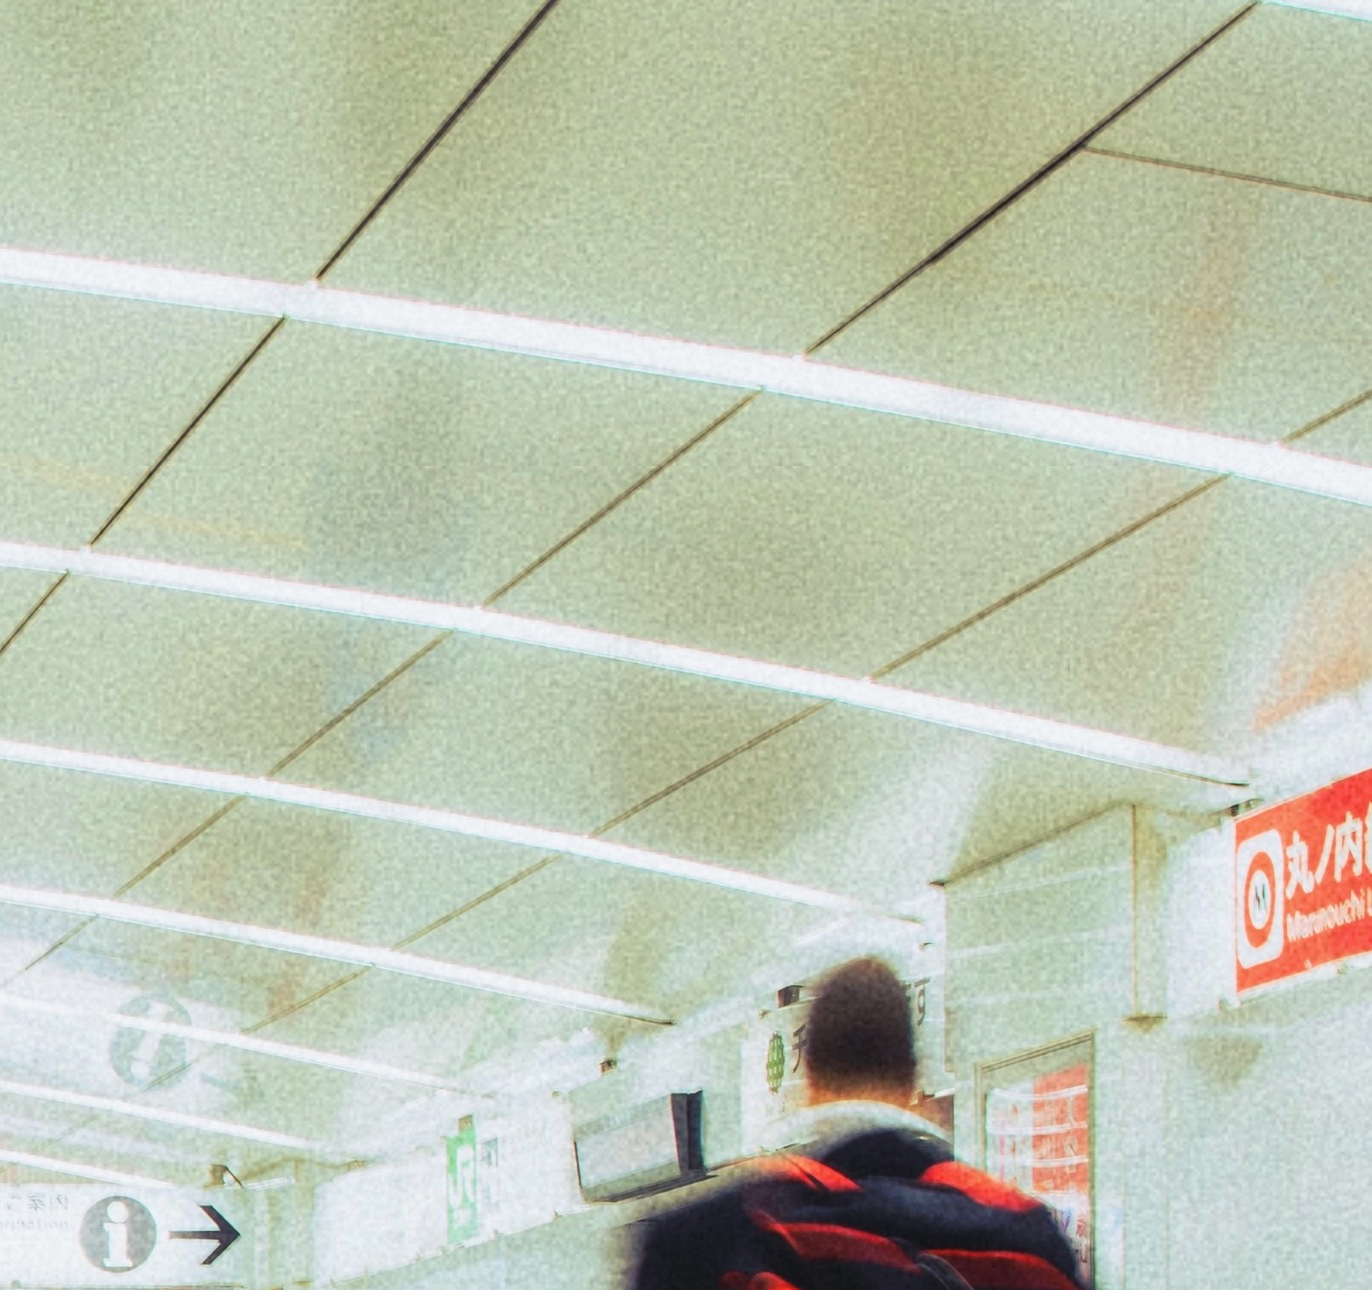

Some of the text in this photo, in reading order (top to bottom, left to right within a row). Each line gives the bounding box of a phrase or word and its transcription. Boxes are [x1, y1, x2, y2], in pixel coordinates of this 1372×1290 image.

[1285, 801, 1372, 900] 丸ノ内
[1286, 888, 1365, 943] Marunouchi
